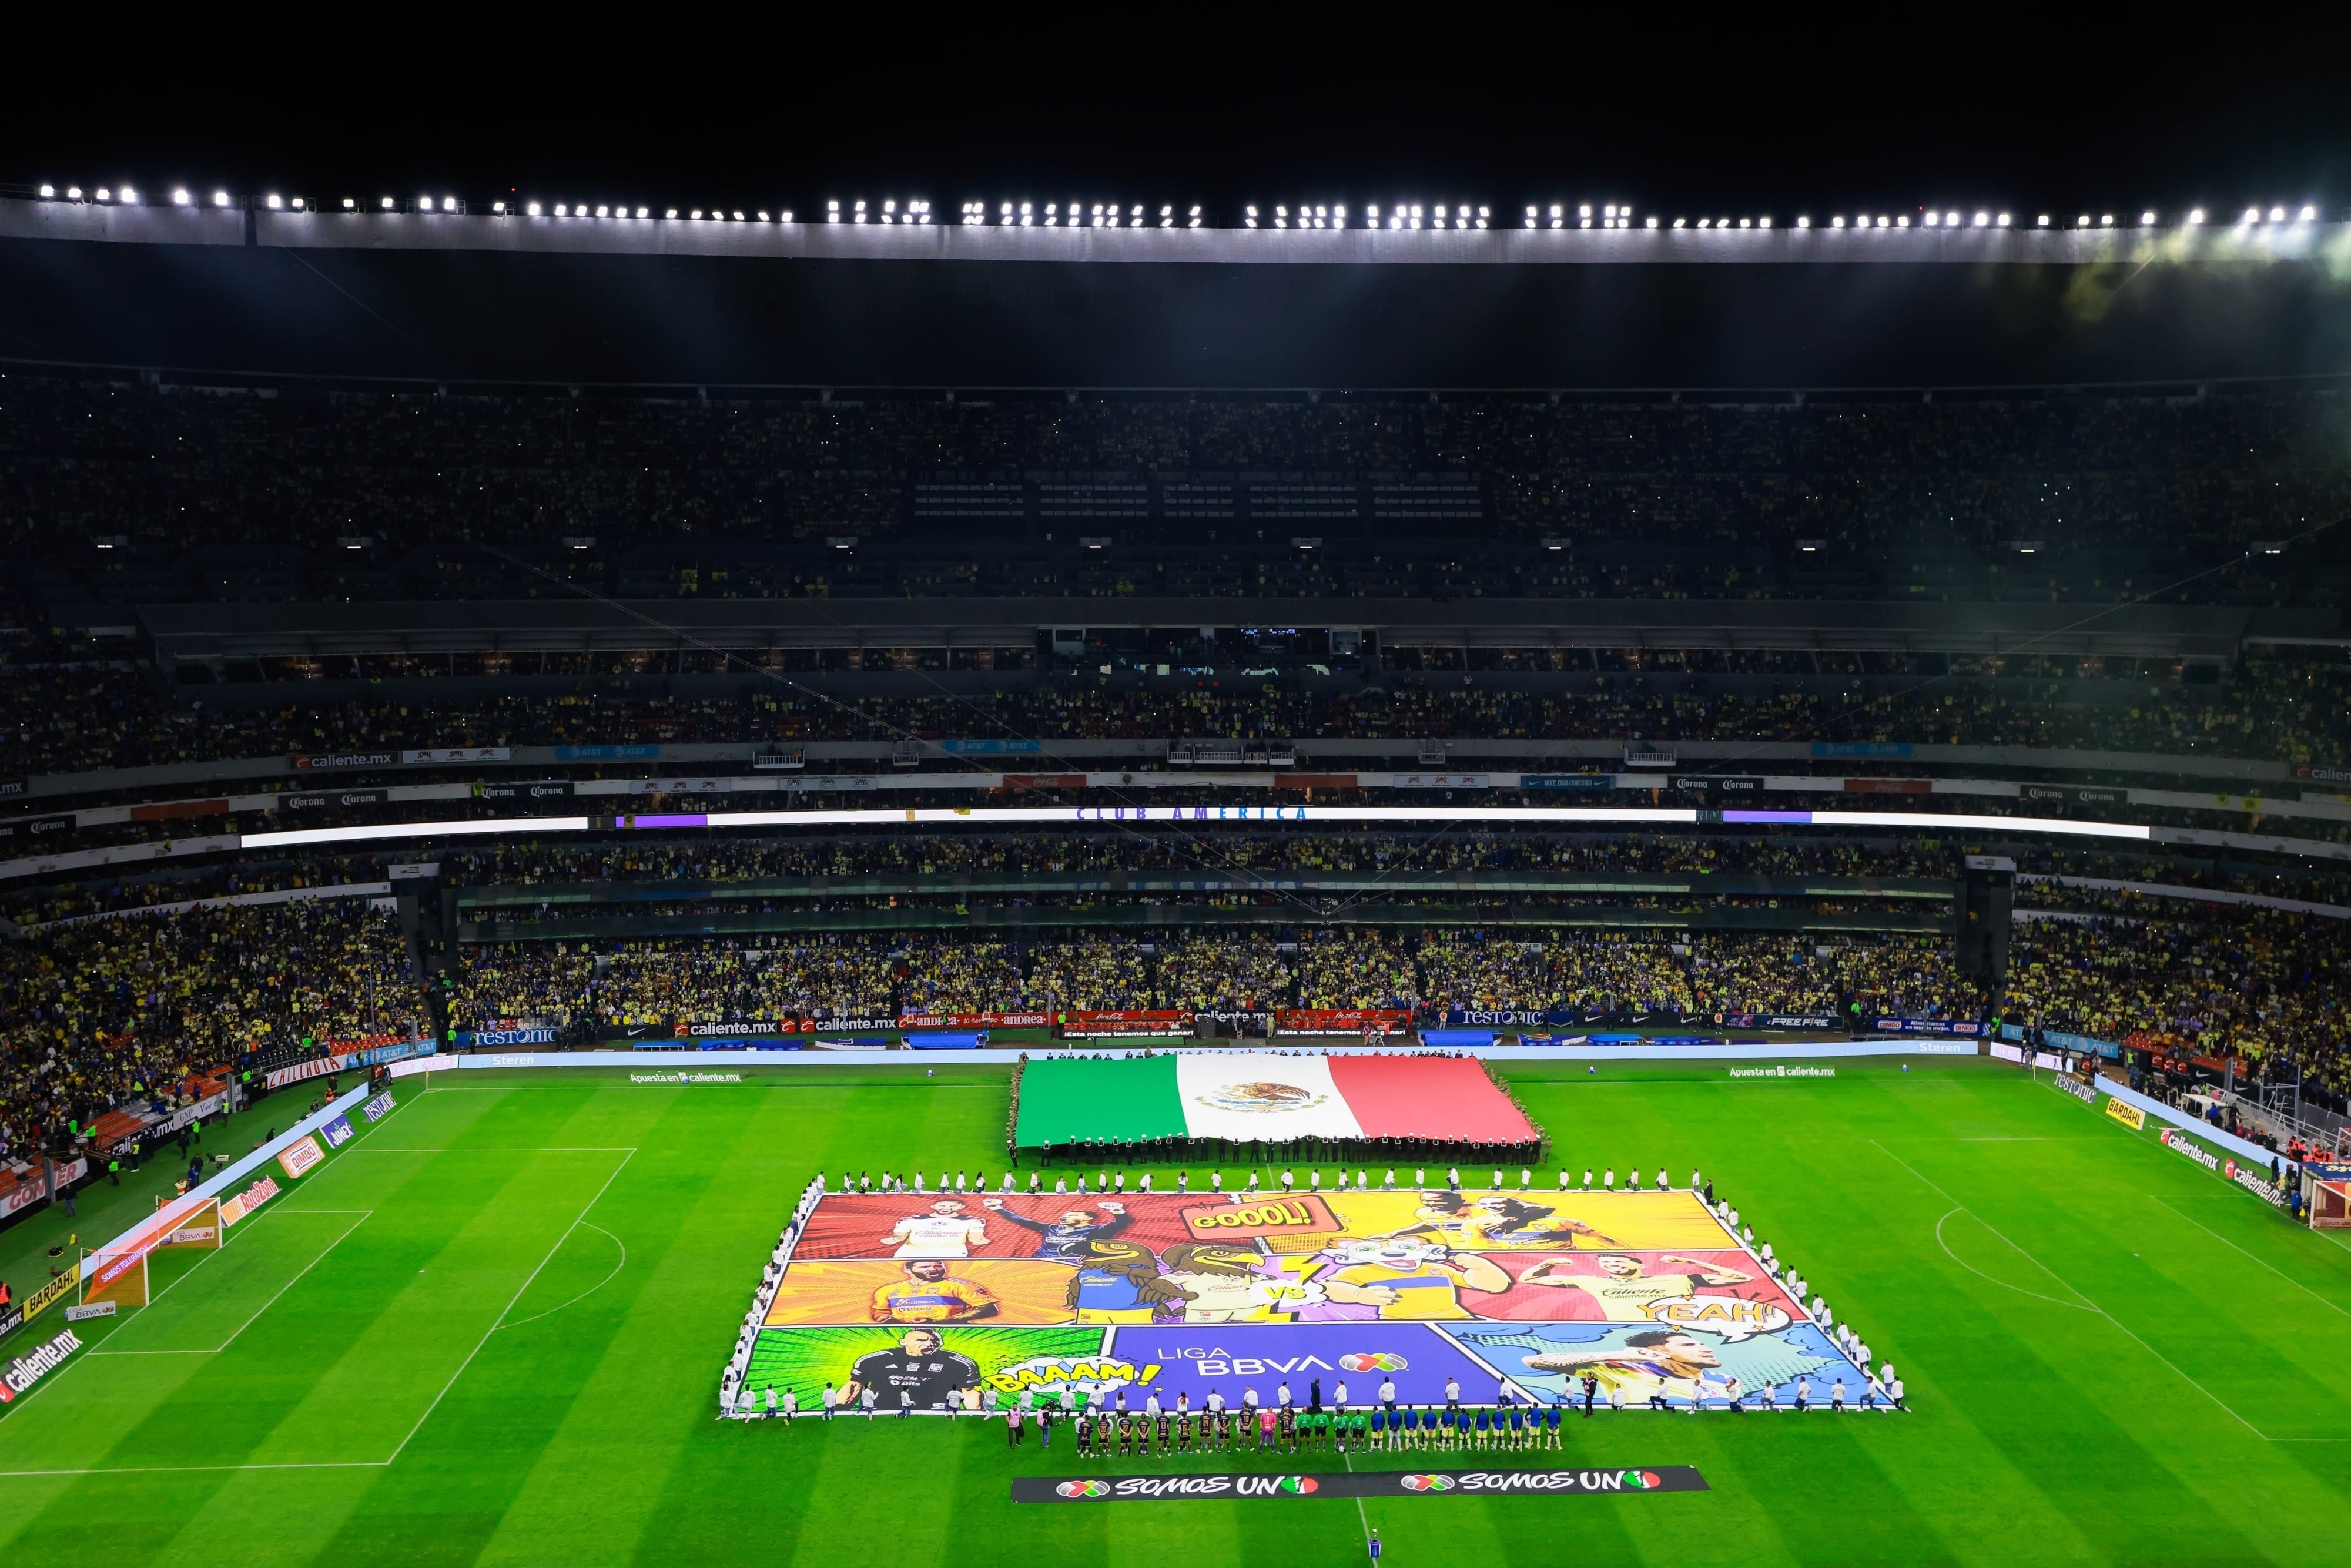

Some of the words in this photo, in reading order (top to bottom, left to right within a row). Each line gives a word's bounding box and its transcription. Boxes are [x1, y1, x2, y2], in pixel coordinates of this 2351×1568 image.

[312, 754, 391, 766] caliente.mx
[1677, 778, 1707, 790] Corona
[1723, 780, 1754, 791] Corona
[483, 788, 515, 799] Corona
[530, 786, 564, 798] Corona
[2029, 788, 2063, 799] Corona
[2079, 790, 2114, 802] Corona
[289, 797, 324, 809] Corona
[341, 794, 376, 806] Corona
[1077, 807, 1146, 820] CLUB
[1173, 806, 1305, 820] AMERICA
[31, 821, 66, 835] Corona
[815, 1018, 896, 1031] caliente.mx
[1802, 1017, 1829, 1026] FIRE
[690, 1022, 776, 1035] caliente.mx
[2050, 1036, 2074, 1045] AT&T
[381, 1048, 402, 1058] AT&T
[1919, 1043, 1960, 1052] Steren
[2092, 1043, 2114, 1053] AT&T
[493, 1056, 534, 1065] Steren
[269, 1058, 340, 1088] CHILCHOTA
[631, 1074, 667, 1083] Apuesta
[689, 1073, 741, 1082] caliente.mx
[1730, 1068, 1764, 1077] Apuesta
[1786, 1067, 1835, 1076] caliente.mx
[180, 1108, 193, 1121] GNP
[2109, 1100, 2139, 1125] BARDAHL
[331, 1122, 354, 1146] JUMEX
[291, 1146, 316, 1168] BIMBO
[2168, 1135, 2219, 1171] caliente.mx
[240, 1177, 278, 1212] AutoZone
[1193, 1201, 1311, 1228] GOOOL!
[31, 1269, 75, 1314] BARDAHL
[1266, 1286, 1307, 1299] VS
[1602, 1288, 1666, 1296] Caliente
[76, 1310, 101, 1319] BBVA
[1637, 1302, 1774, 1322] YEAH!
[1157, 1347, 1232, 1359] LIGA
[6, 1329, 83, 1392] caliente.mx
[1197, 1354, 1335, 1376] BBVA
[982, 1362, 1163, 1393] BAAAM!
[1114, 1477, 1231, 1496] SOMOS
[1458, 1472, 1575, 1492] SOMOS
